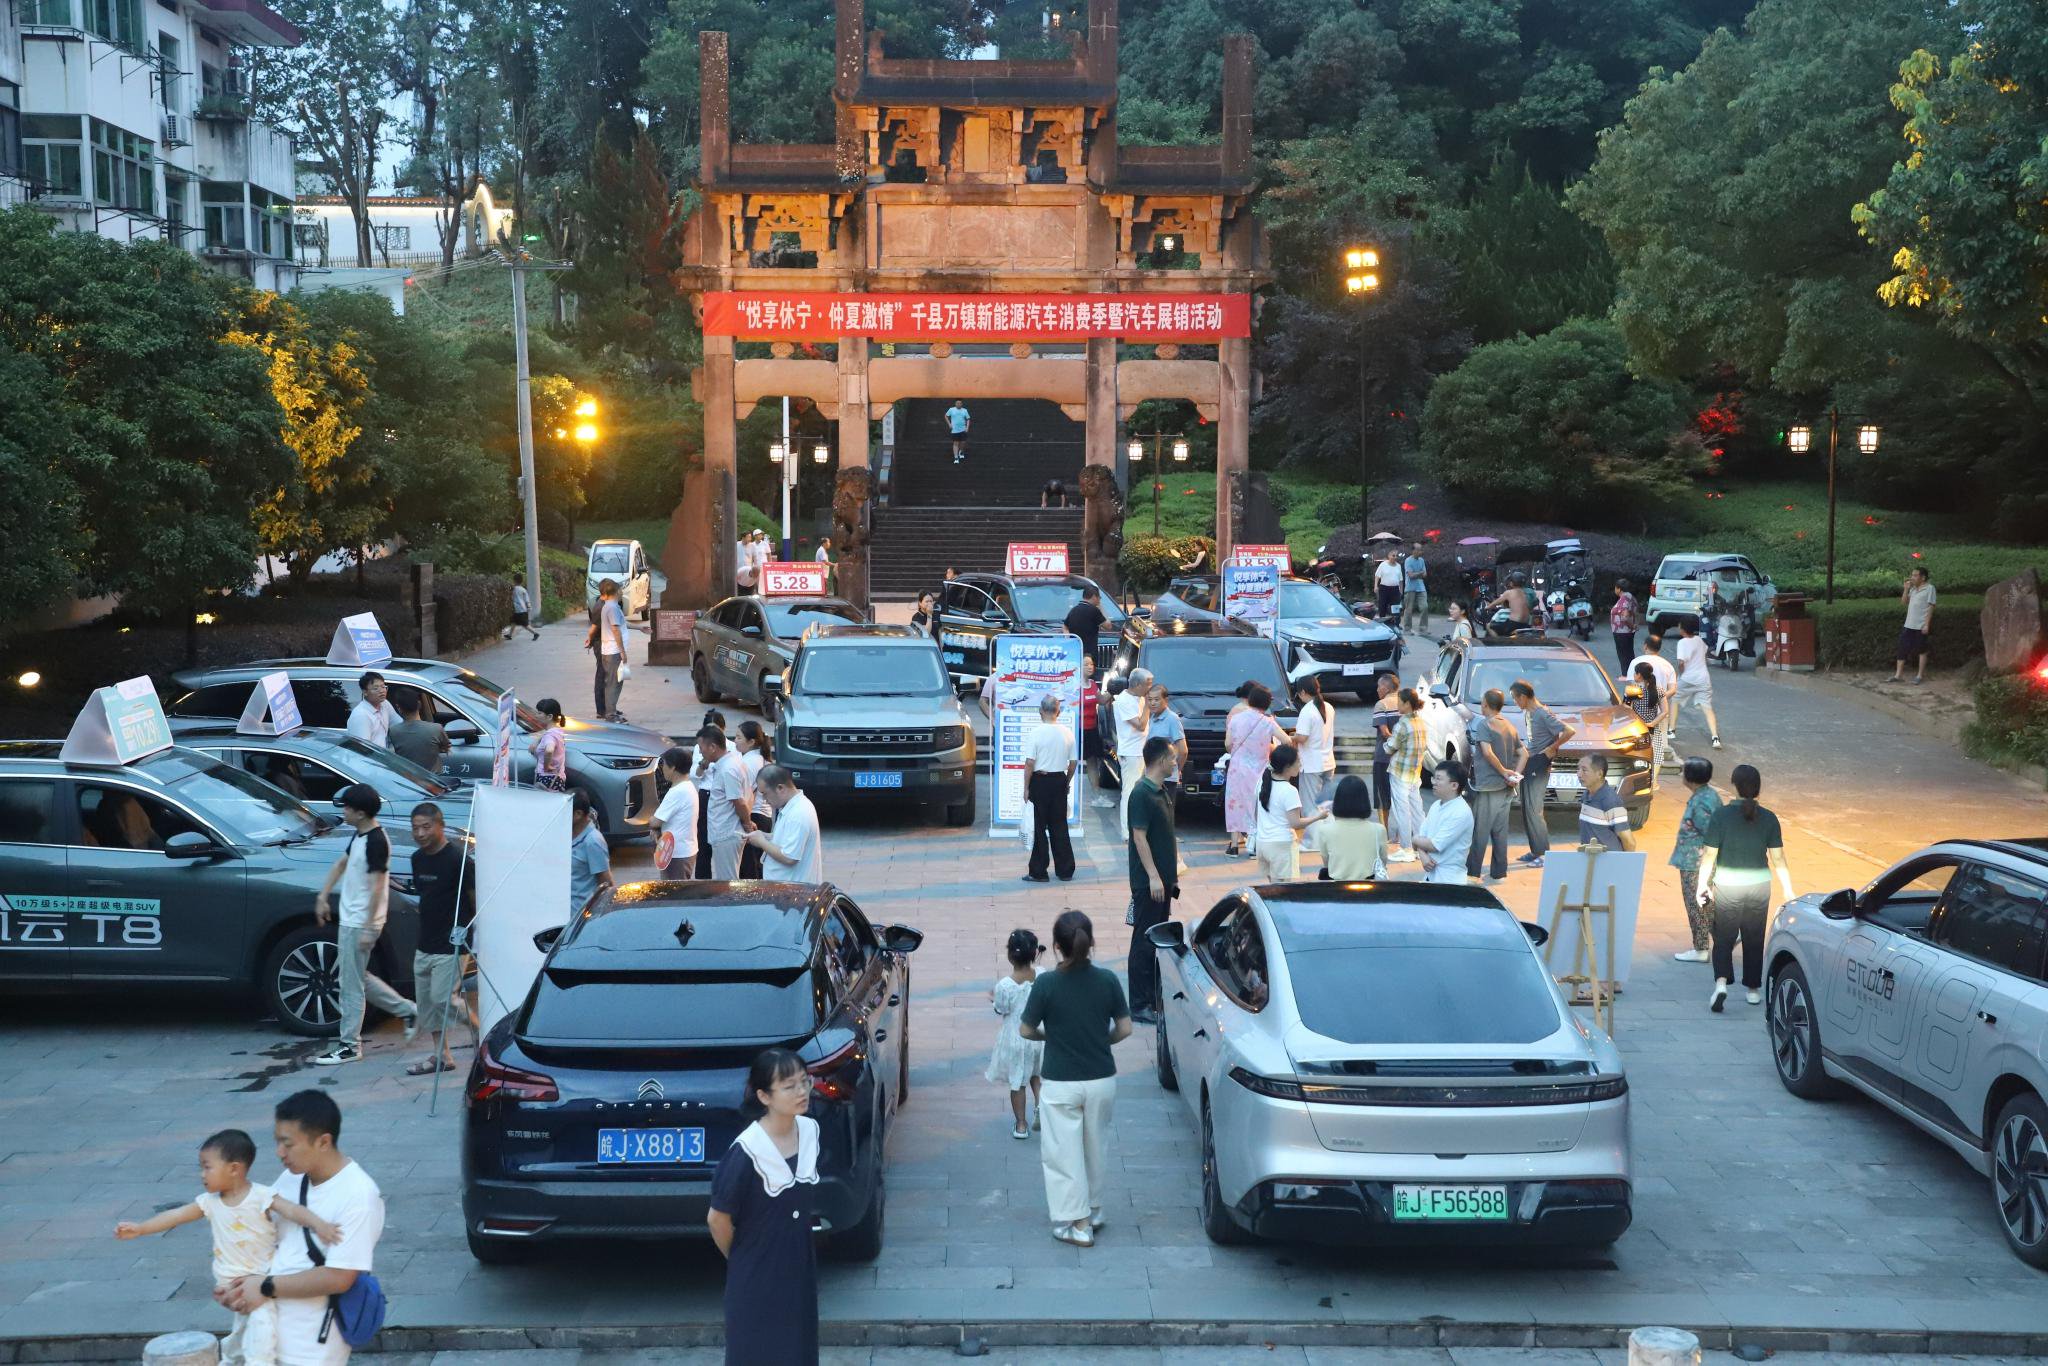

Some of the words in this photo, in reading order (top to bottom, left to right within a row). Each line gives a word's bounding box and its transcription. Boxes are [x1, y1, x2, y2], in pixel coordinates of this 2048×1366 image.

[1019, 557, 1052, 570] 9.77
[773, 576, 809, 590] 5.28
[81, 914, 163, 945] T8
